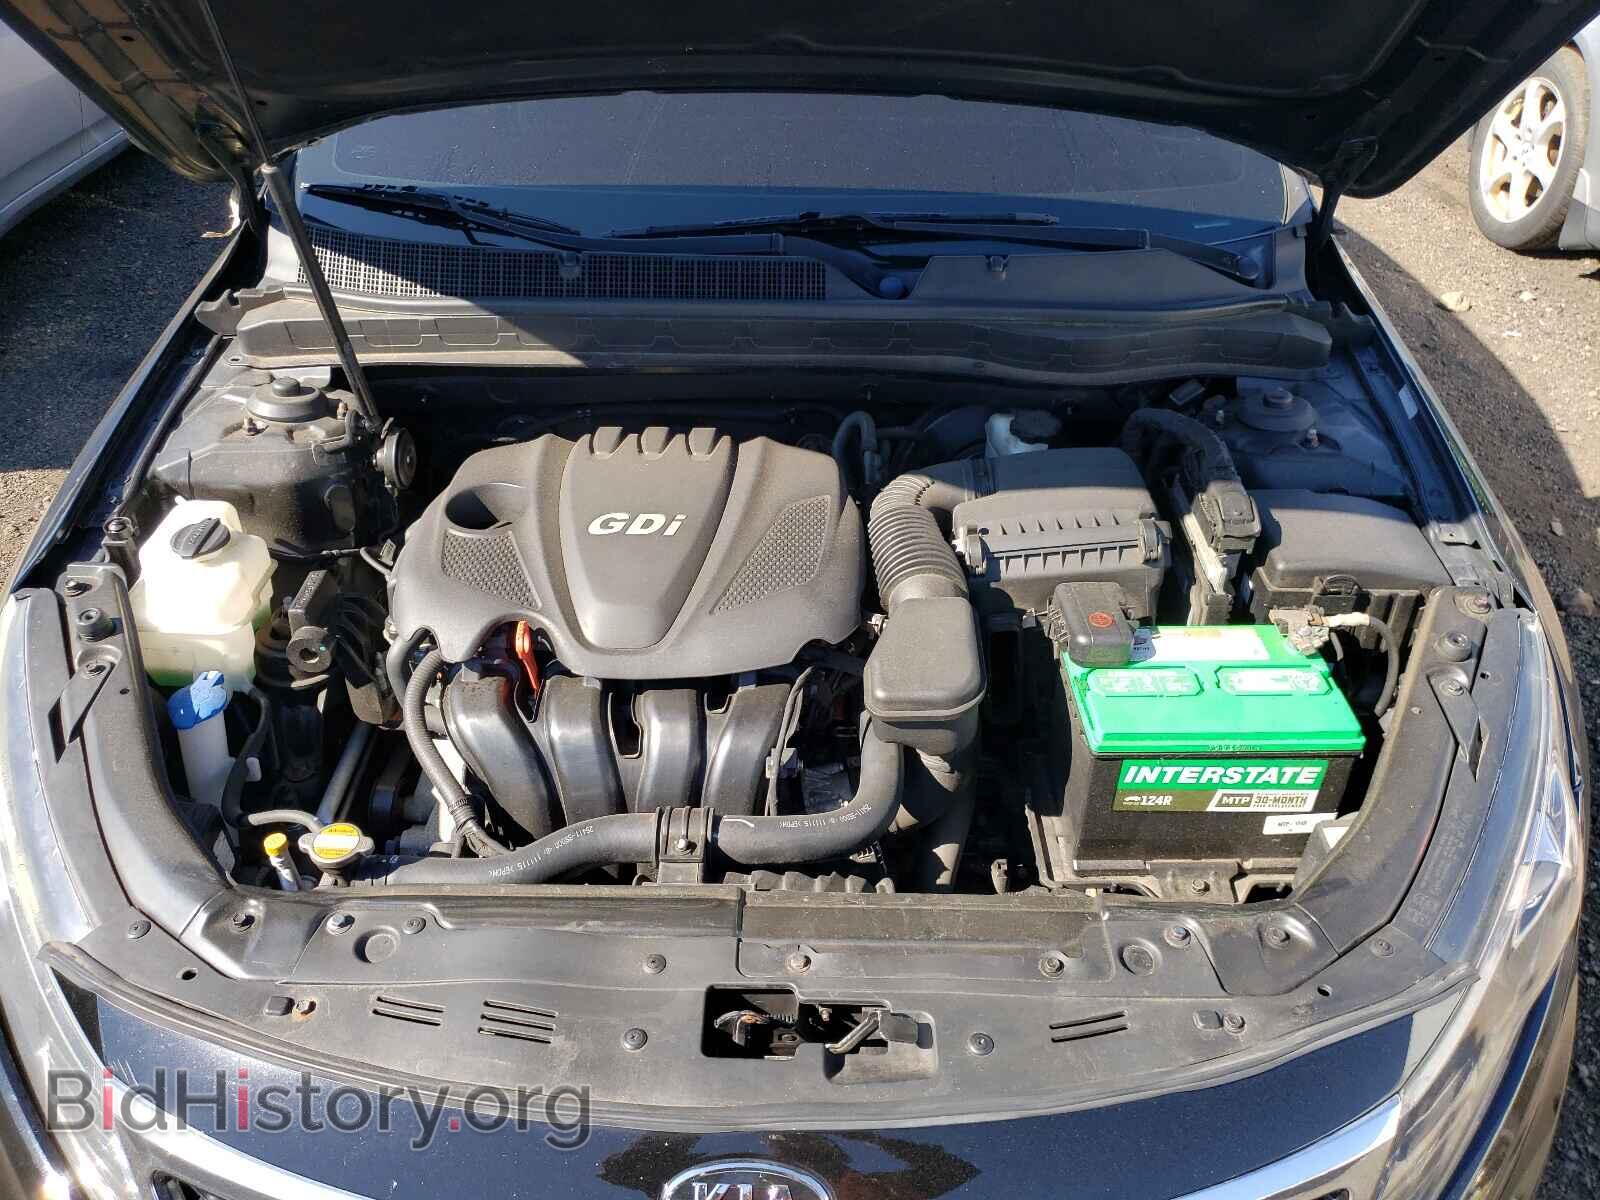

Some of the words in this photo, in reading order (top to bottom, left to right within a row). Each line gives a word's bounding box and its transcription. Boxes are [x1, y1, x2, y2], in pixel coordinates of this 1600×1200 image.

[587, 512, 688, 536] GDi
[1123, 765, 1322, 785] INTERSTATE
[1140, 795, 1173, 806] 124R
[1221, 796, 1250, 805] MTP
[1254, 796, 1308, 804] 30-MONTH
